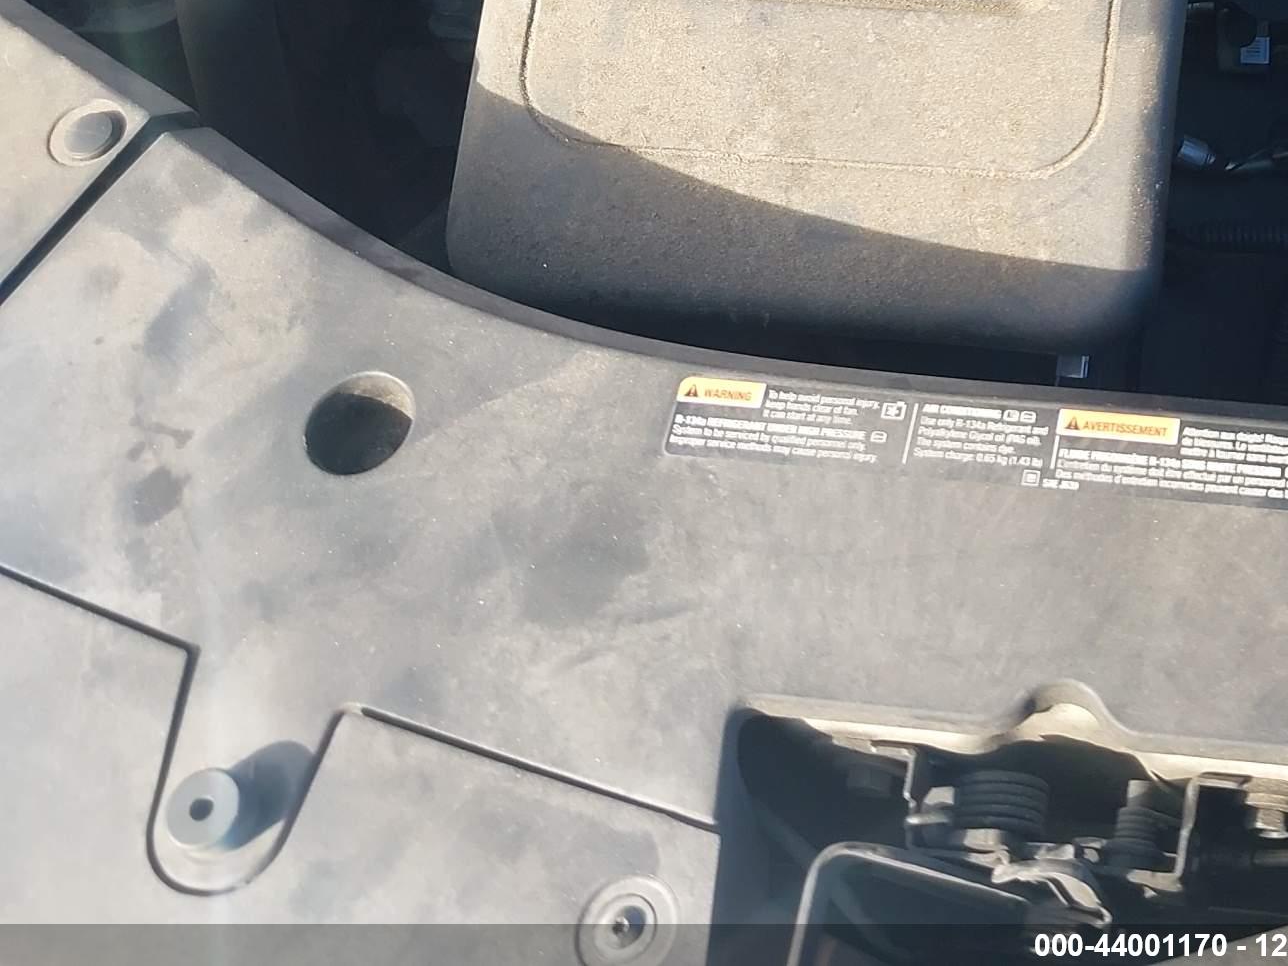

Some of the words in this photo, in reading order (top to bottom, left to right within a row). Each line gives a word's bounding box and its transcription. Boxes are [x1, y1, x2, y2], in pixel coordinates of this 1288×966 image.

[704, 388, 752, 402] WARNING
[674, 425, 702, 438] System
[1084, 421, 1168, 437] AVERTISSEMENT
[914, 449, 944, 461] System
